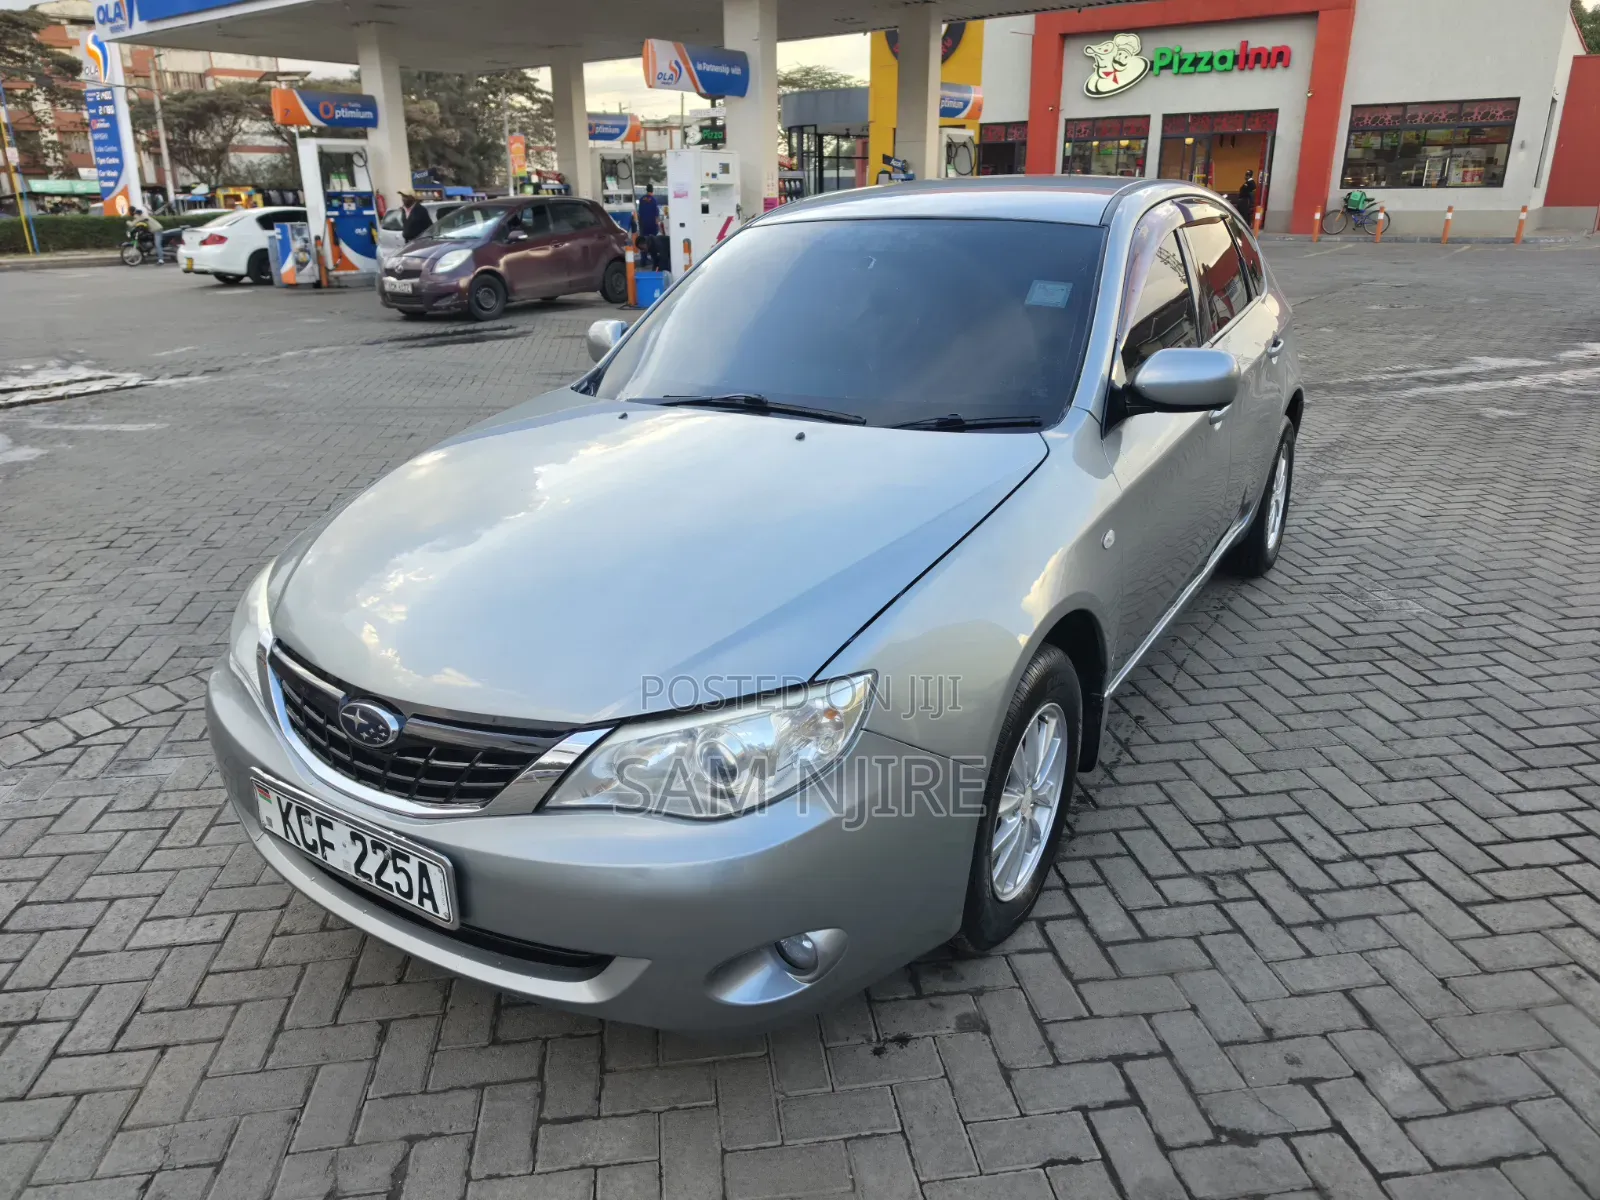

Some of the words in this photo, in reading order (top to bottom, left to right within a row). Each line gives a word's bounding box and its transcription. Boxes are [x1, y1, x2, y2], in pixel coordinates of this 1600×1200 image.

[96, 1, 124, 25] OLA
[657, 71, 674, 81] OLA
[940, 98, 964, 109] ptimium
[702, 128, 723, 139] Pizza
[276, 795, 335, 861] KCF
[349, 830, 440, 915] 225A
